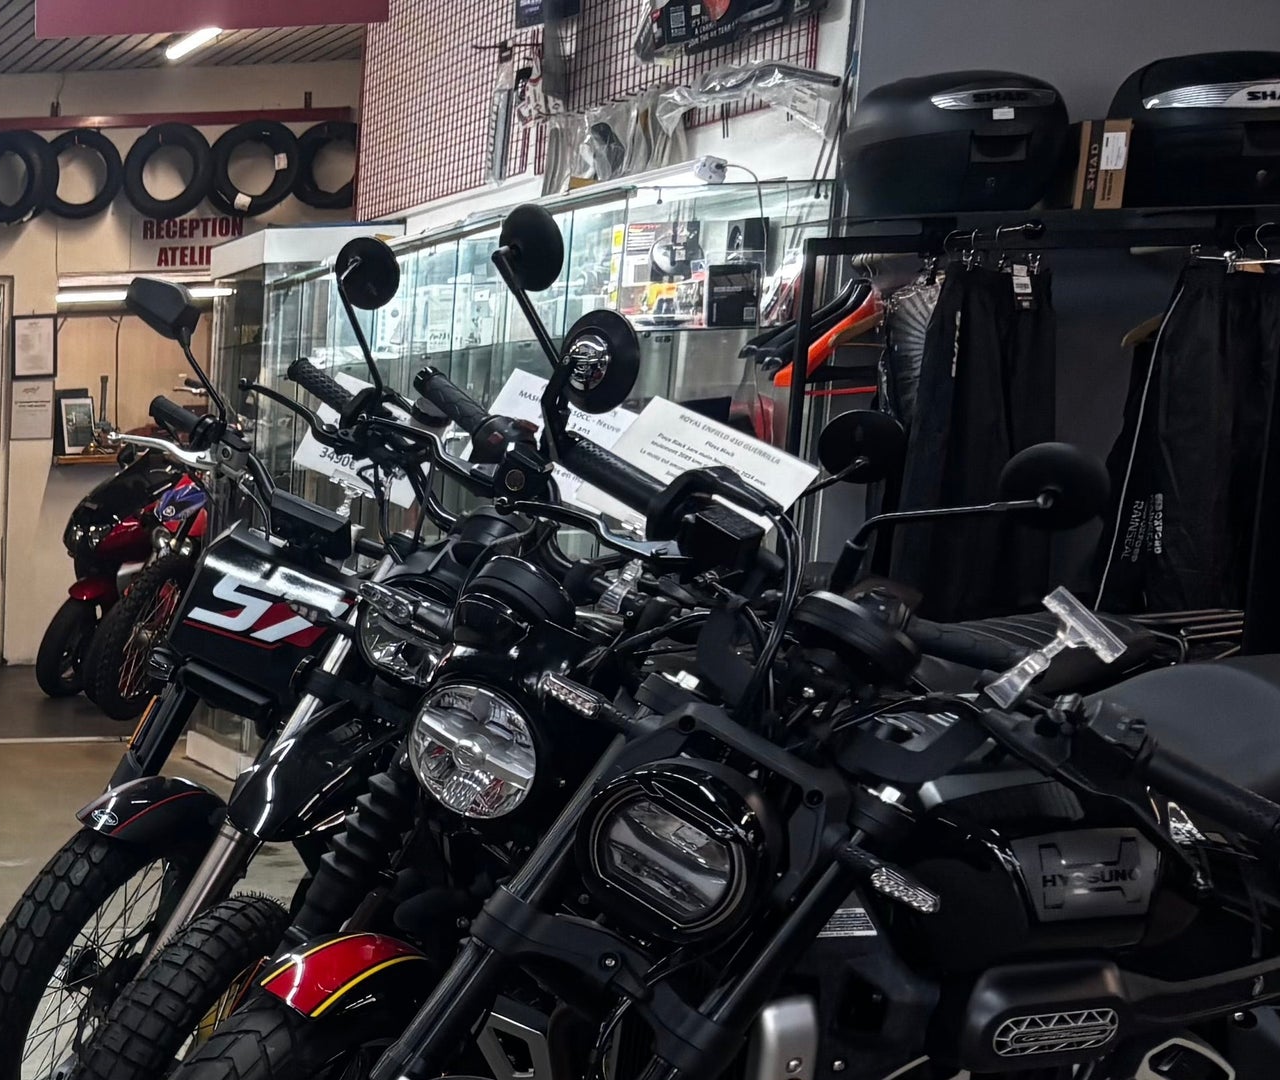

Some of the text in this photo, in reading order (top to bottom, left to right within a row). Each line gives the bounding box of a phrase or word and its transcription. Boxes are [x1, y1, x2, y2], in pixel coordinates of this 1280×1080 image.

[1086, 143, 1099, 190] SHAD
[142, 216, 244, 241] RECEPTION
[156, 246, 212, 267] ATELI
[679, 413, 702, 430] ROYAL
[701, 423, 730, 441] ENFIELD
[742, 442, 781, 466] GUERRILLA
[1120, 499, 1145, 561] RAINSEAL
